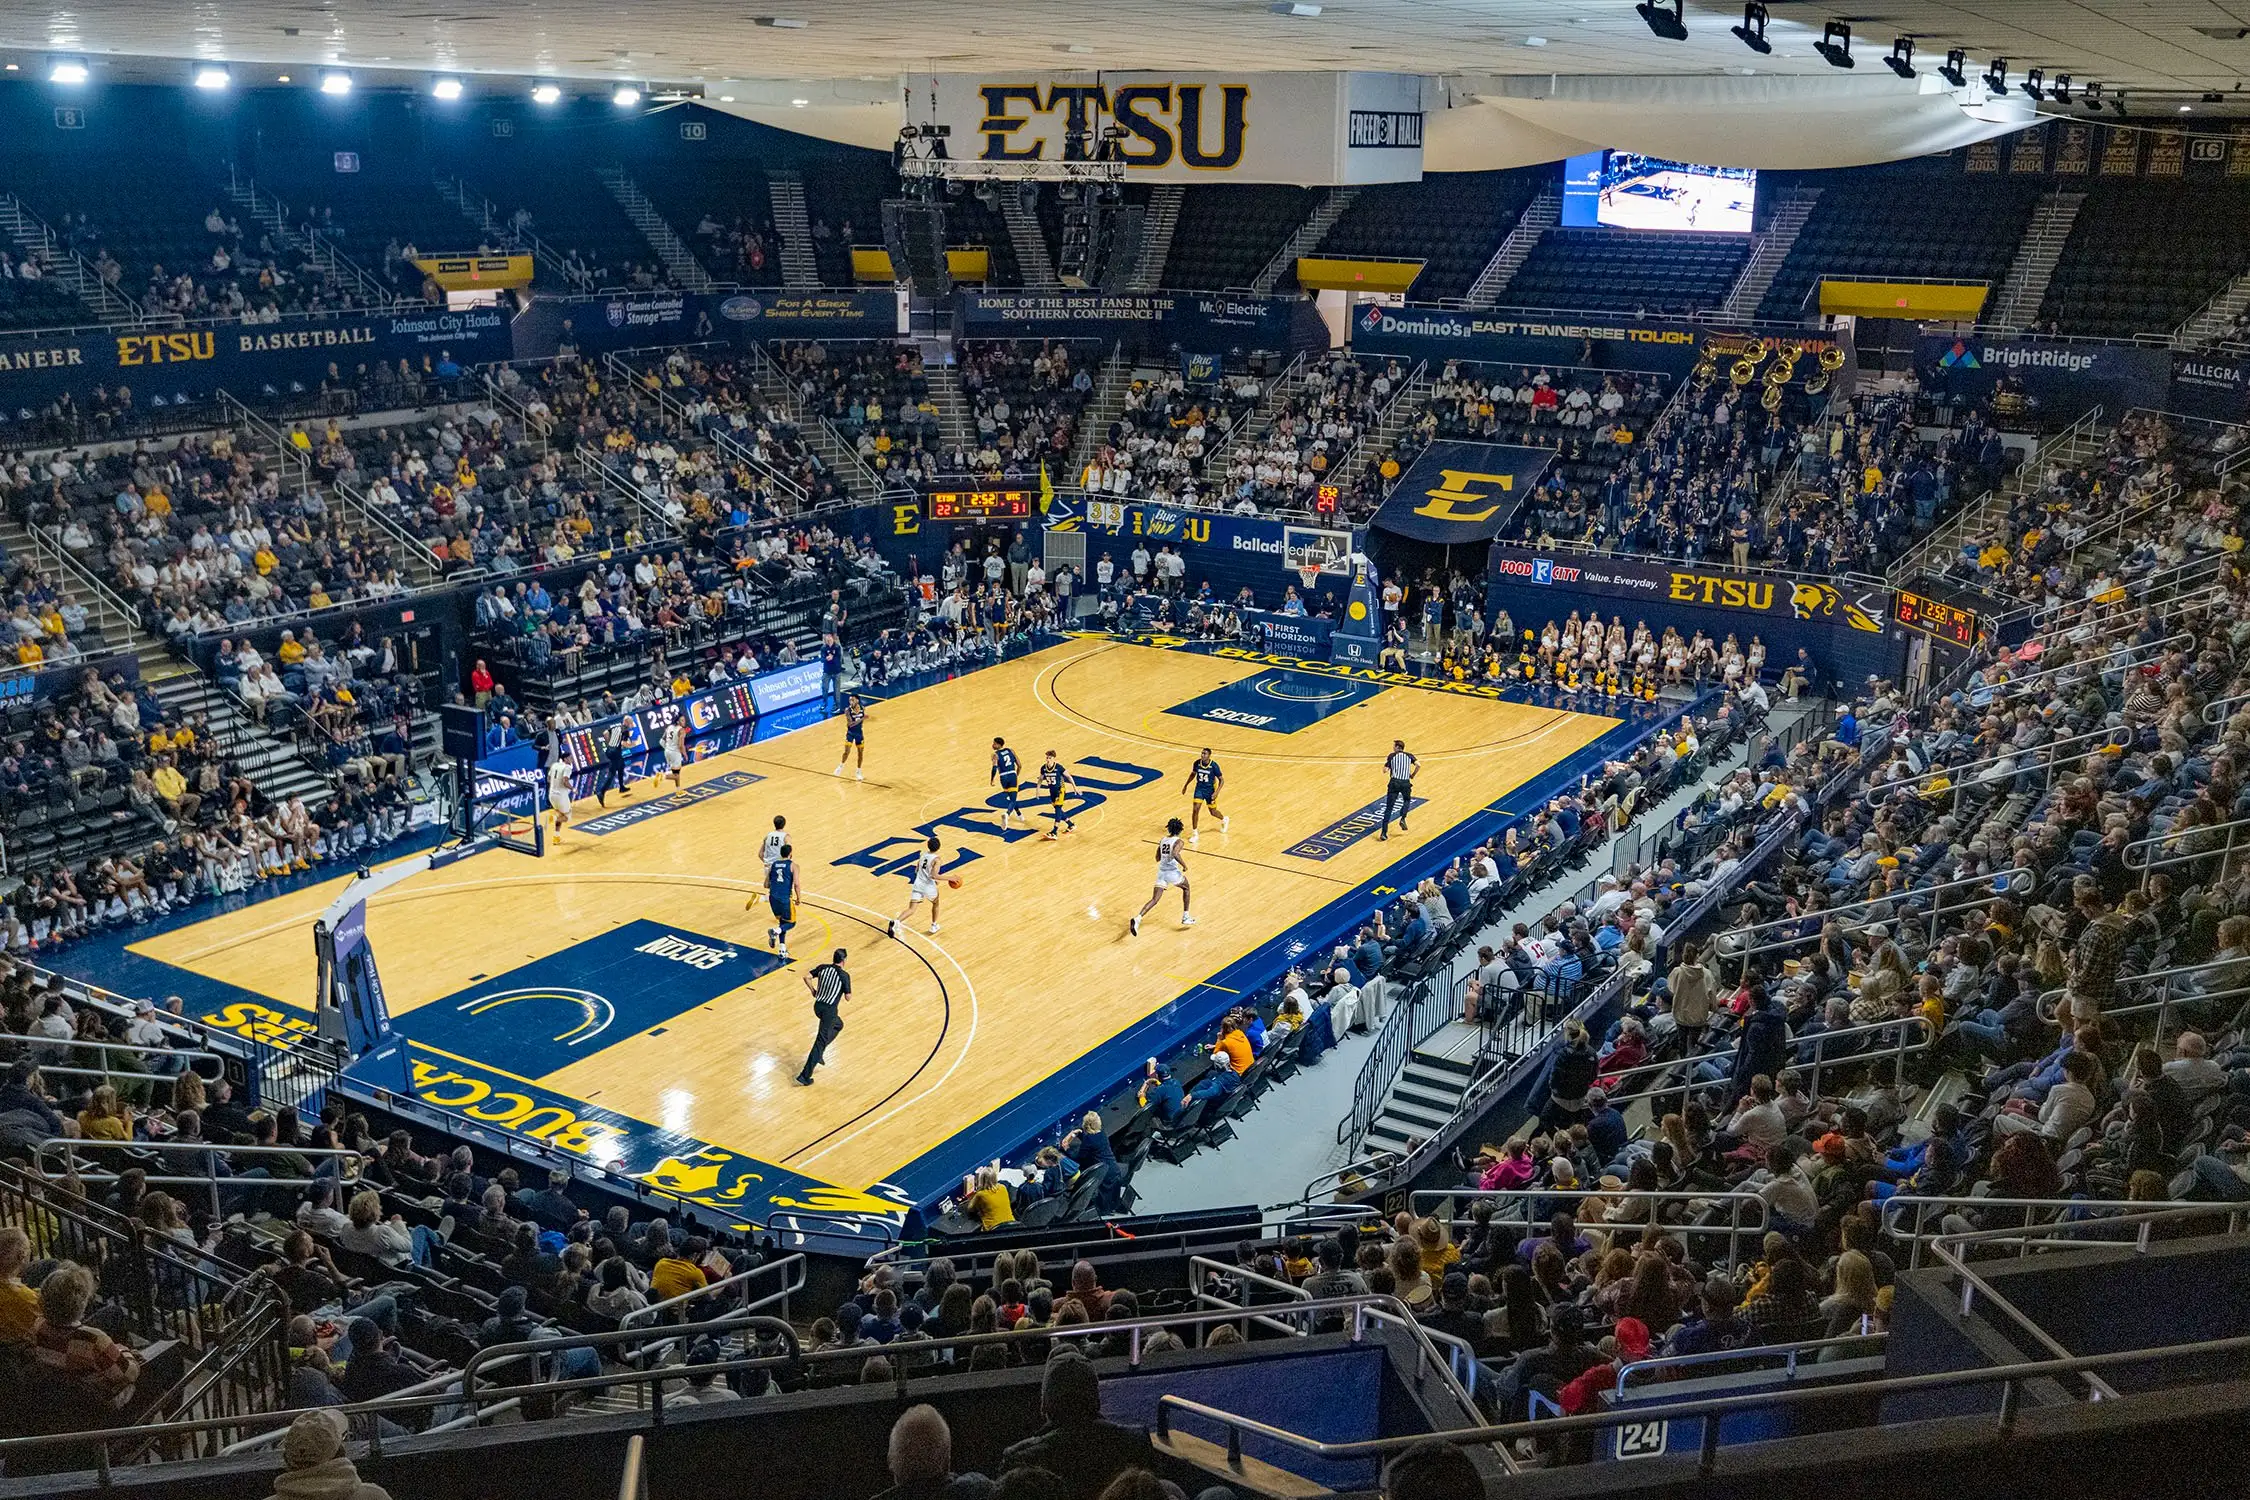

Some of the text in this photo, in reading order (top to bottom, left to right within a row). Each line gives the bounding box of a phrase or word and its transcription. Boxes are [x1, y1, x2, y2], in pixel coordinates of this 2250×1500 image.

[685, 125, 702, 138] 10
[978, 84, 1250, 170] ETSU
[1350, 113, 1420, 145] FREEDOM HALL
[2196, 142, 2219, 159] 16
[626, 301, 650, 312] Climate
[651, 298, 684, 310] Controlled
[803, 299, 813, 308] A
[978, 299, 1175, 310] HOME OF THE BEST FANS IN THE
[1200, 301, 1268, 316] Mr. Electric
[609, 309, 623, 320] 381
[626, 312, 659, 326] Storage
[1002, 309, 1154, 320] SOUTHERN CONFERENCE
[391, 312, 501, 334] Johnson City Honda
[1382, 316, 1463, 338] Domino's
[240, 327, 376, 351] BASKETBALL
[1472, 320, 1694, 345] EAST TENNESSEE TOUGH
[117, 331, 215, 366] ETSU
[1983, 347, 2092, 372] BrightRidge
[2182, 362, 2240, 382] ALLEGRA
[936, 494, 957, 503] ETSU
[970, 493, 997, 505] 2:52
[1005, 493, 1021, 501] UTC
[1319, 486, 1338, 498] 2:52
[1414, 469, 1513, 522] E
[936, 505, 951, 516] 22
[1011, 502, 1027, 514] 31
[1090, 503, 1103, 520] 3
[1317, 496, 1335, 512] 29
[894, 503, 920, 535] E
[1108, 505, 1121, 522] 3
[1500, 559, 1533, 577] FOOD
[1551, 566, 1581, 582] CITY
[1585, 571, 1611, 583] Value.
[1613, 575, 1659, 590] Everyday.
[1669, 573, 1774, 610] ETSU
[1902, 594, 1917, 606] ETSU
[1901, 606, 1912, 621] 22
[1926, 602, 1946, 621] 2:52
[1953, 611, 1966, 624] UTC
[1274, 623, 1301, 634] FIRST
[1957, 625, 1969, 641] 31
[1274, 631, 1316, 643] HORIZON
[1214, 647, 1505, 698] BUCCANEERS
[757, 681, 787, 695] Johnson
[787, 676, 803, 688] City
[704, 703, 720, 720] 31
[1004, 754, 1012, 766] 2
[1198, 772, 1209, 782] 34
[830, 756, 1164, 885] ETSU
[769, 836, 779, 847] 13
[1161, 843, 1171, 855] 22
[921, 858, 928, 869] 2
[776, 868, 784, 882] 1
[1531, 942, 1545, 959] 13
[370, 977, 380, 995] City
[375, 993, 388, 1022] Johnson
[1386, 1194, 1403, 1211] 22
[1622, 1420, 1661, 1451] 24
